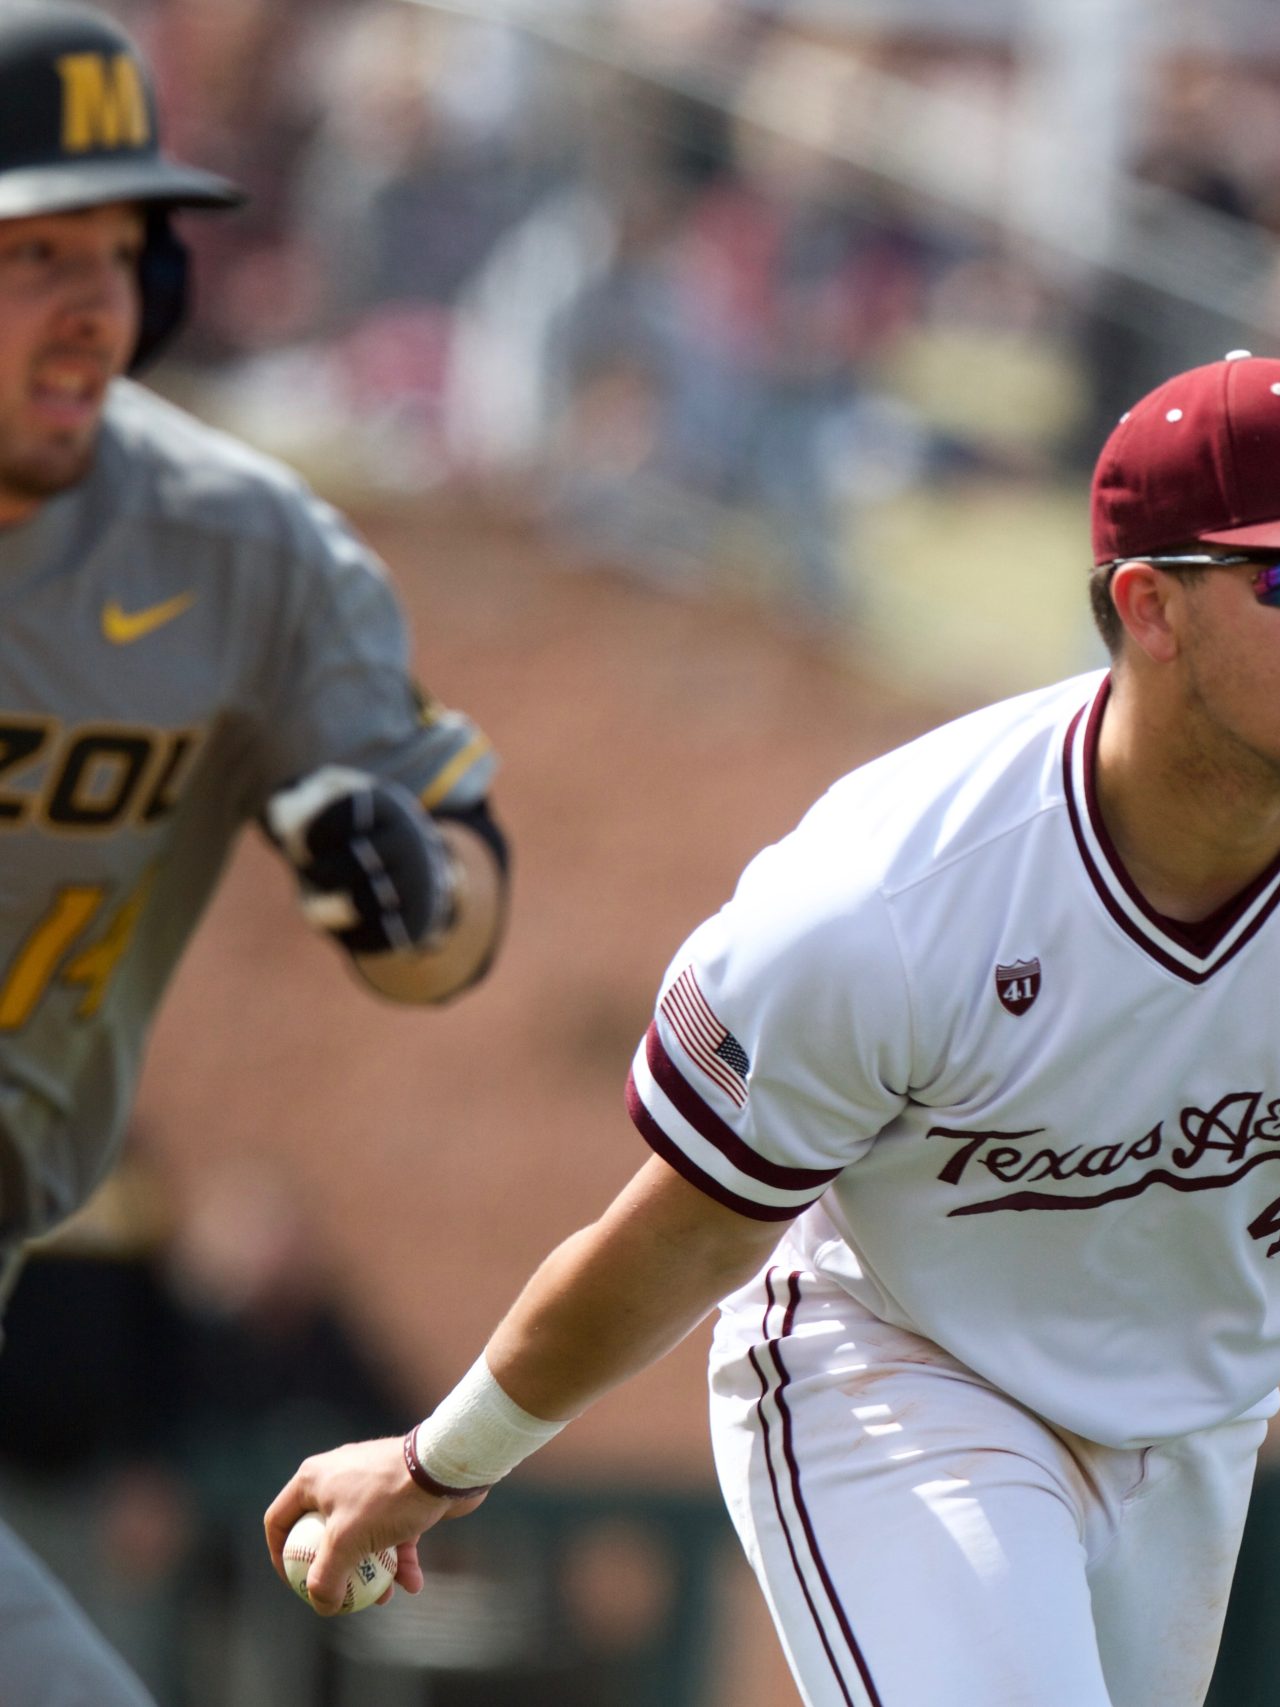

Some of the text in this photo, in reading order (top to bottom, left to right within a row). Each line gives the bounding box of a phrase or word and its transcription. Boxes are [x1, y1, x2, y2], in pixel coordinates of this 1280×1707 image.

[57, 53, 151, 152] M
[1003, 977, 1035, 1002] 41
[926, 1121, 1165, 1185] Texas
